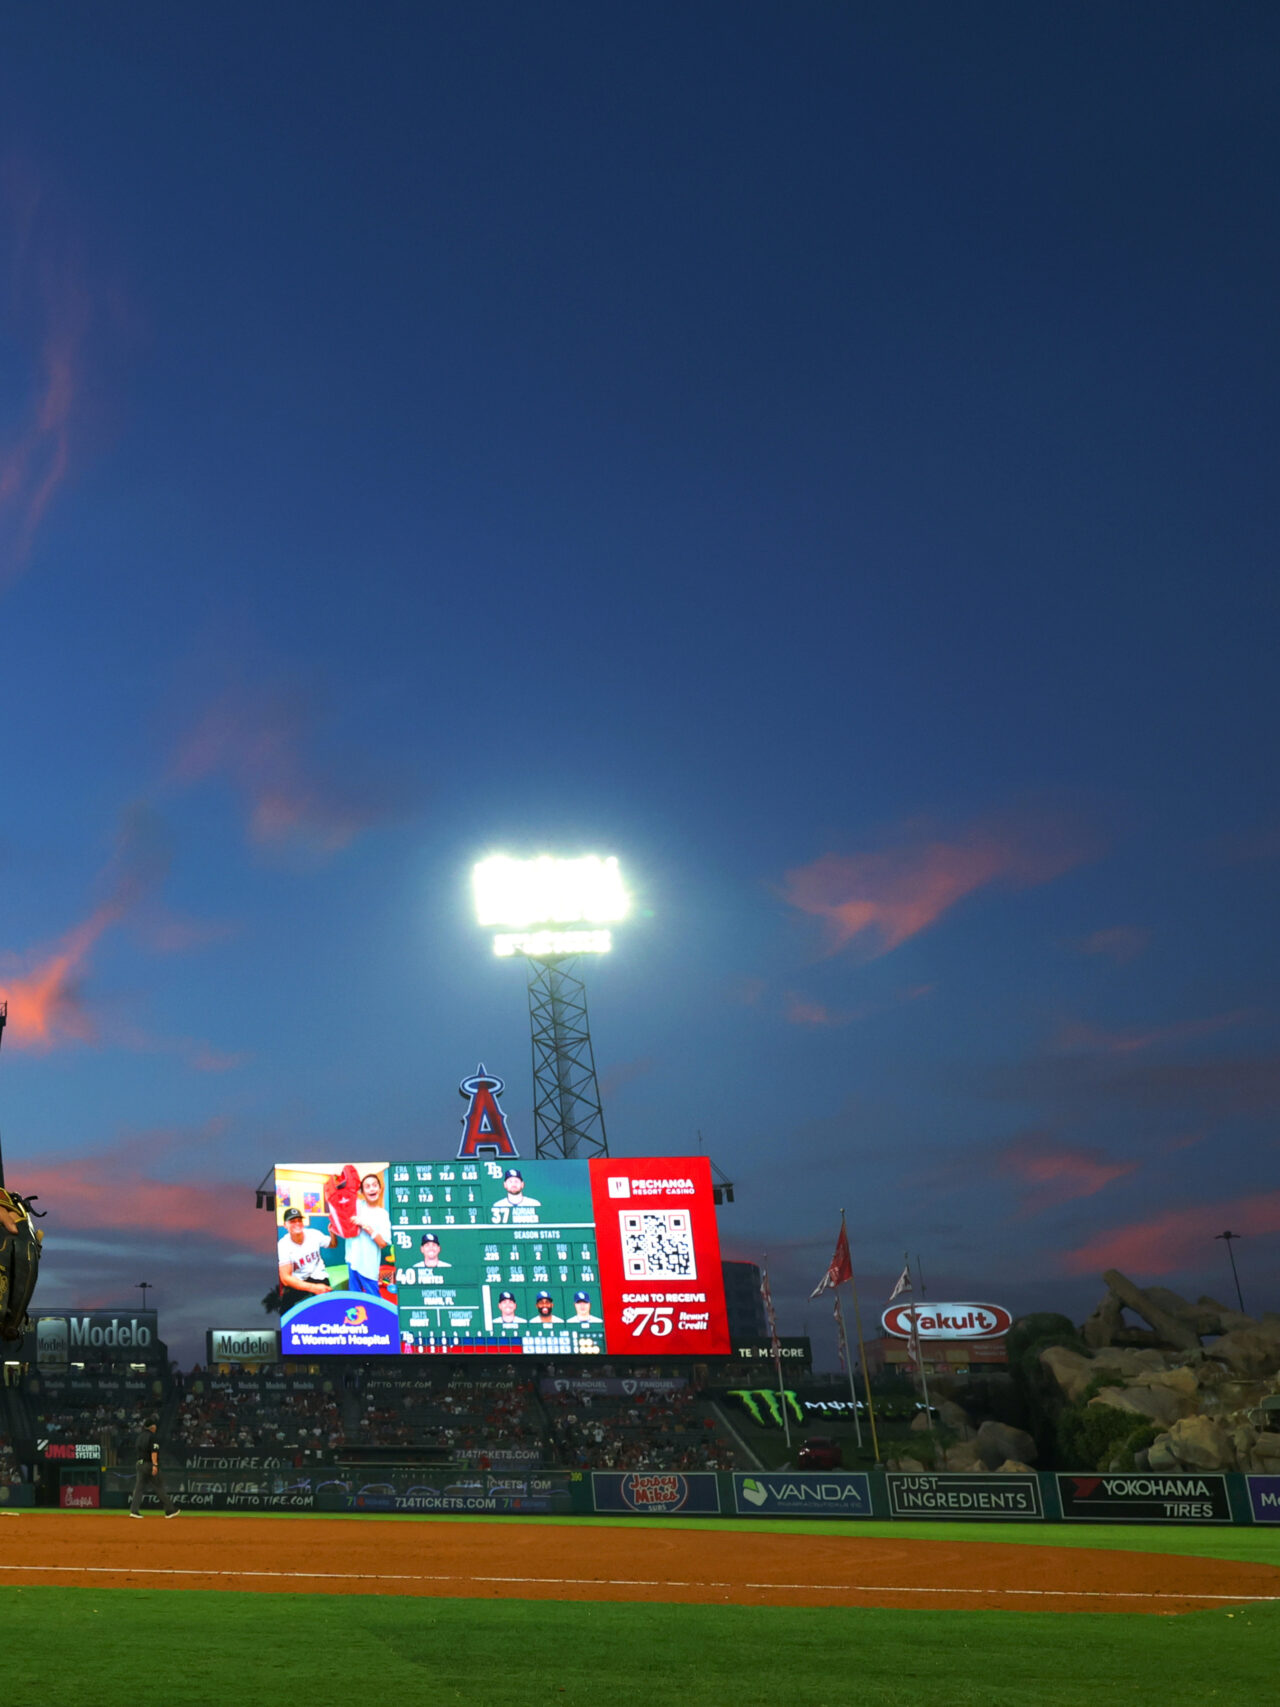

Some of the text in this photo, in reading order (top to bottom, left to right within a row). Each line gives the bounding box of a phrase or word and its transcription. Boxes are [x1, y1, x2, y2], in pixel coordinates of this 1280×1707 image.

[456, 1062, 520, 1159] A
[415, 1165, 432, 1173] WHIP
[443, 1164, 450, 1172] IP
[484, 1162, 503, 1179] TB
[632, 1179, 694, 1189] PECHANGA
[491, 1207, 510, 1224] 37
[393, 1231, 412, 1248] TB
[513, 1230, 560, 1239] SEASON STATS
[293, 1251, 320, 1272] ANGEL
[396, 1268, 416, 1285] 40
[622, 1293, 706, 1303] SCAN TO RECEIVE
[621, 1306, 674, 1336] $75
[903, 1313, 993, 1330] Yakult
[70, 1317, 151, 1347] Modelo
[291, 1324, 368, 1334] Miller Children's
[221, 1336, 269, 1354] Modelo
[291, 1334, 390, 1346] & Women's Hospital
[739, 1349, 768, 1358] TEM
[45, 1444, 76, 1459] JMG
[75, 1451, 101, 1459] SYSTEMS
[629, 1474, 678, 1489] Jersey
[900, 1477, 939, 1490] JUST
[1102, 1480, 1210, 1496] YOKOHAMA
[128, 1494, 214, 1505] NTTO IRE.COM
[635, 1488, 680, 1503] Mike's
[768, 1484, 862, 1500] VANDA
[226, 1495, 314, 1506] NITTO TIRE.COM
[395, 1497, 496, 1509] 714TICKETS.COM
[902, 1492, 1028, 1508] INGREDIENTS
[1163, 1503, 1213, 1517] TIRES
